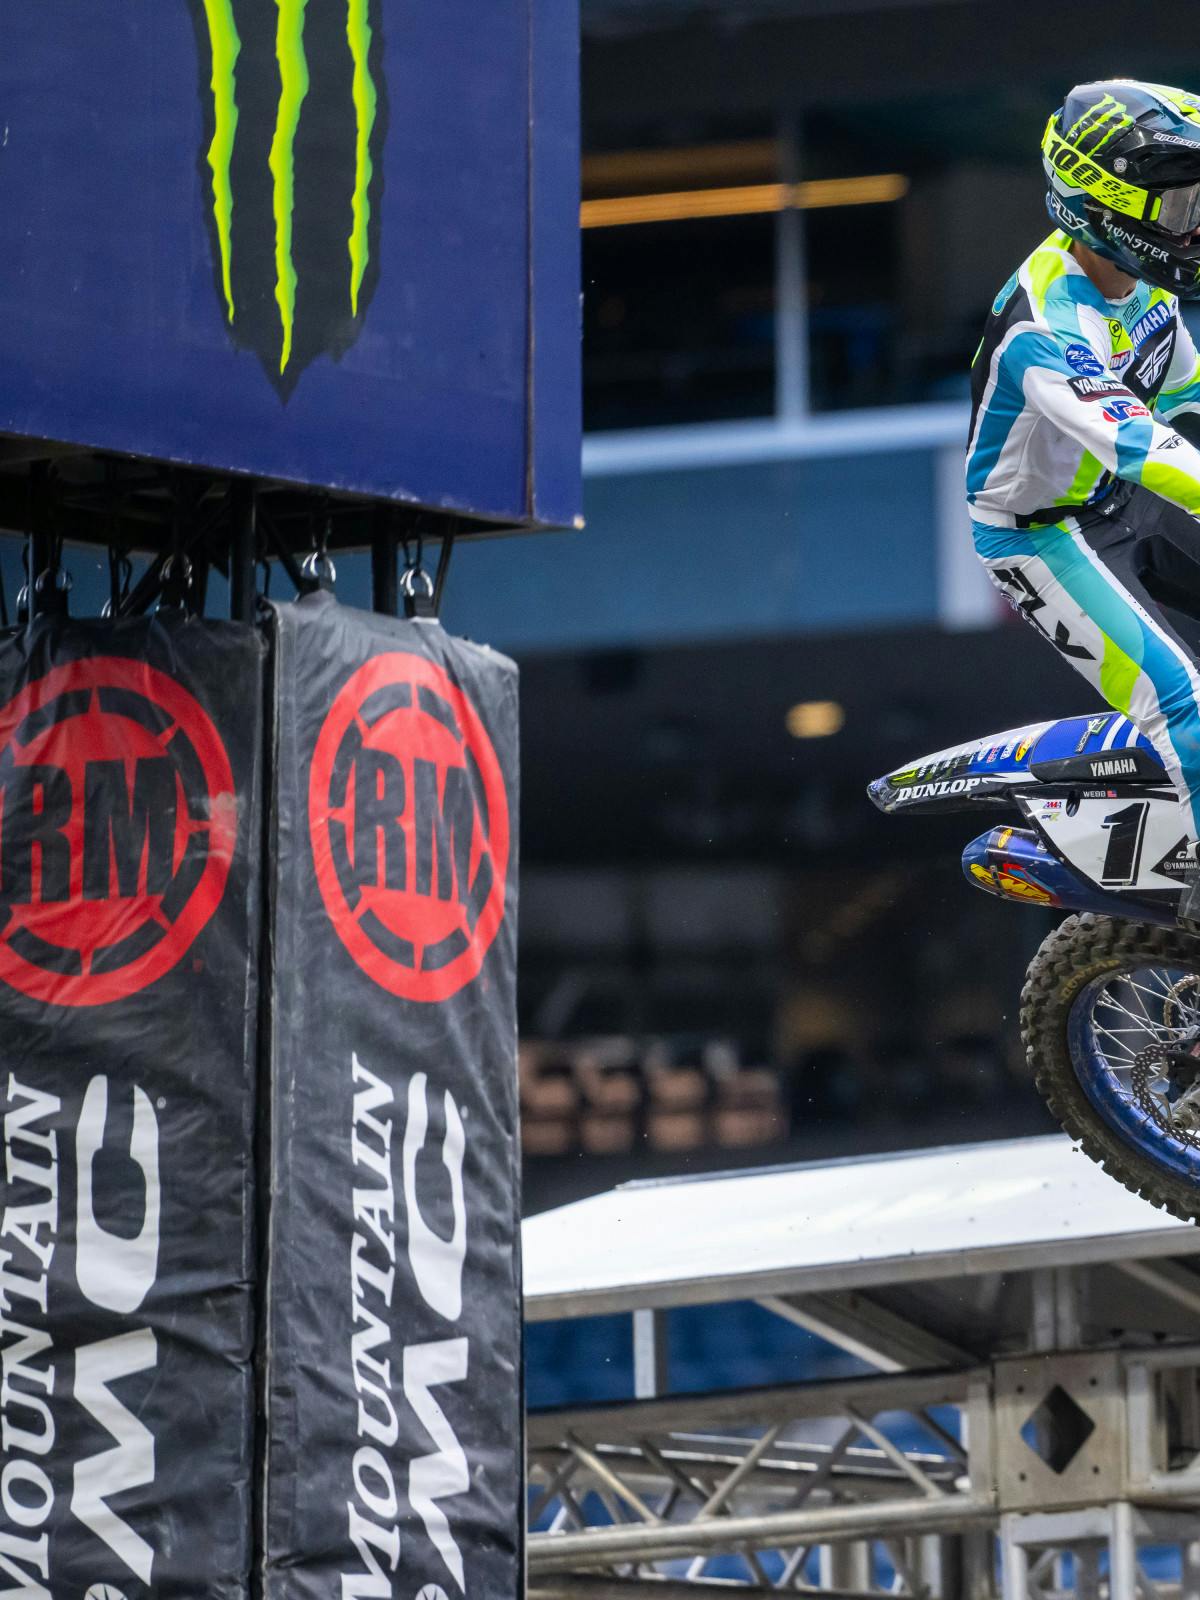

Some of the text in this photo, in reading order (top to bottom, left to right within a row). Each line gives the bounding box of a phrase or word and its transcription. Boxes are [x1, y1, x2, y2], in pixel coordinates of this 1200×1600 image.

[1048, 140, 1138, 210] 100%
[1101, 217, 1171, 264] MONSTER
[896, 776, 981, 803] DUNLOP
[1089, 757, 1138, 777] YAMAHA
[1083, 790, 1107, 798] WEBB
[351, 750, 476, 902] RM
[1100, 800, 1150, 887] 1
